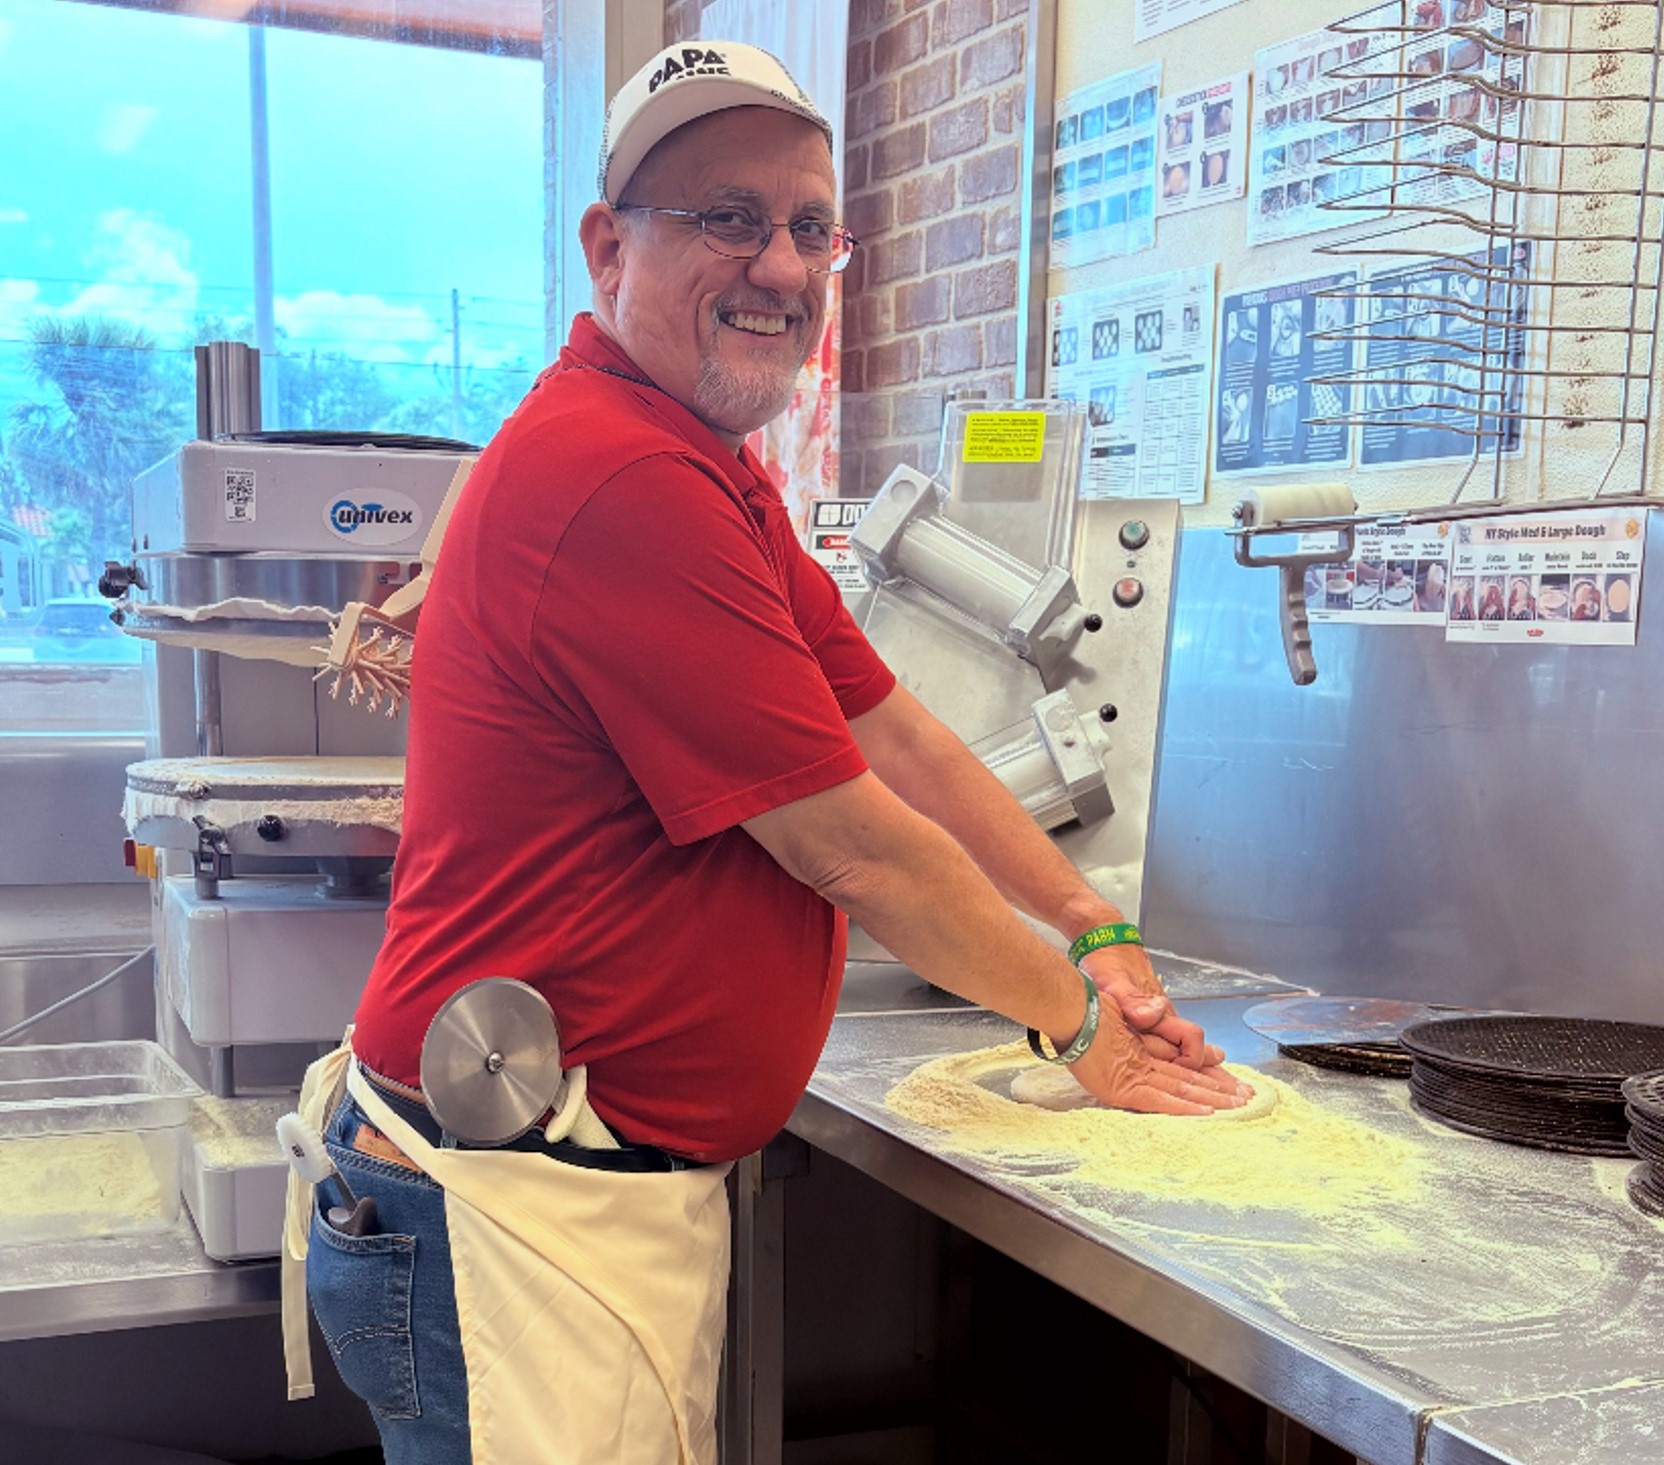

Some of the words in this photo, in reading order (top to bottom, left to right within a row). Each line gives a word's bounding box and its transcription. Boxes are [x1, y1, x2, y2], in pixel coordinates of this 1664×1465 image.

[649, 49, 725, 94] PAPA
[338, 503, 414, 524] univex
[1497, 527, 1520, 541] Style
[1548, 525, 1574, 541] Large
[1575, 523, 1606, 539] Dough
